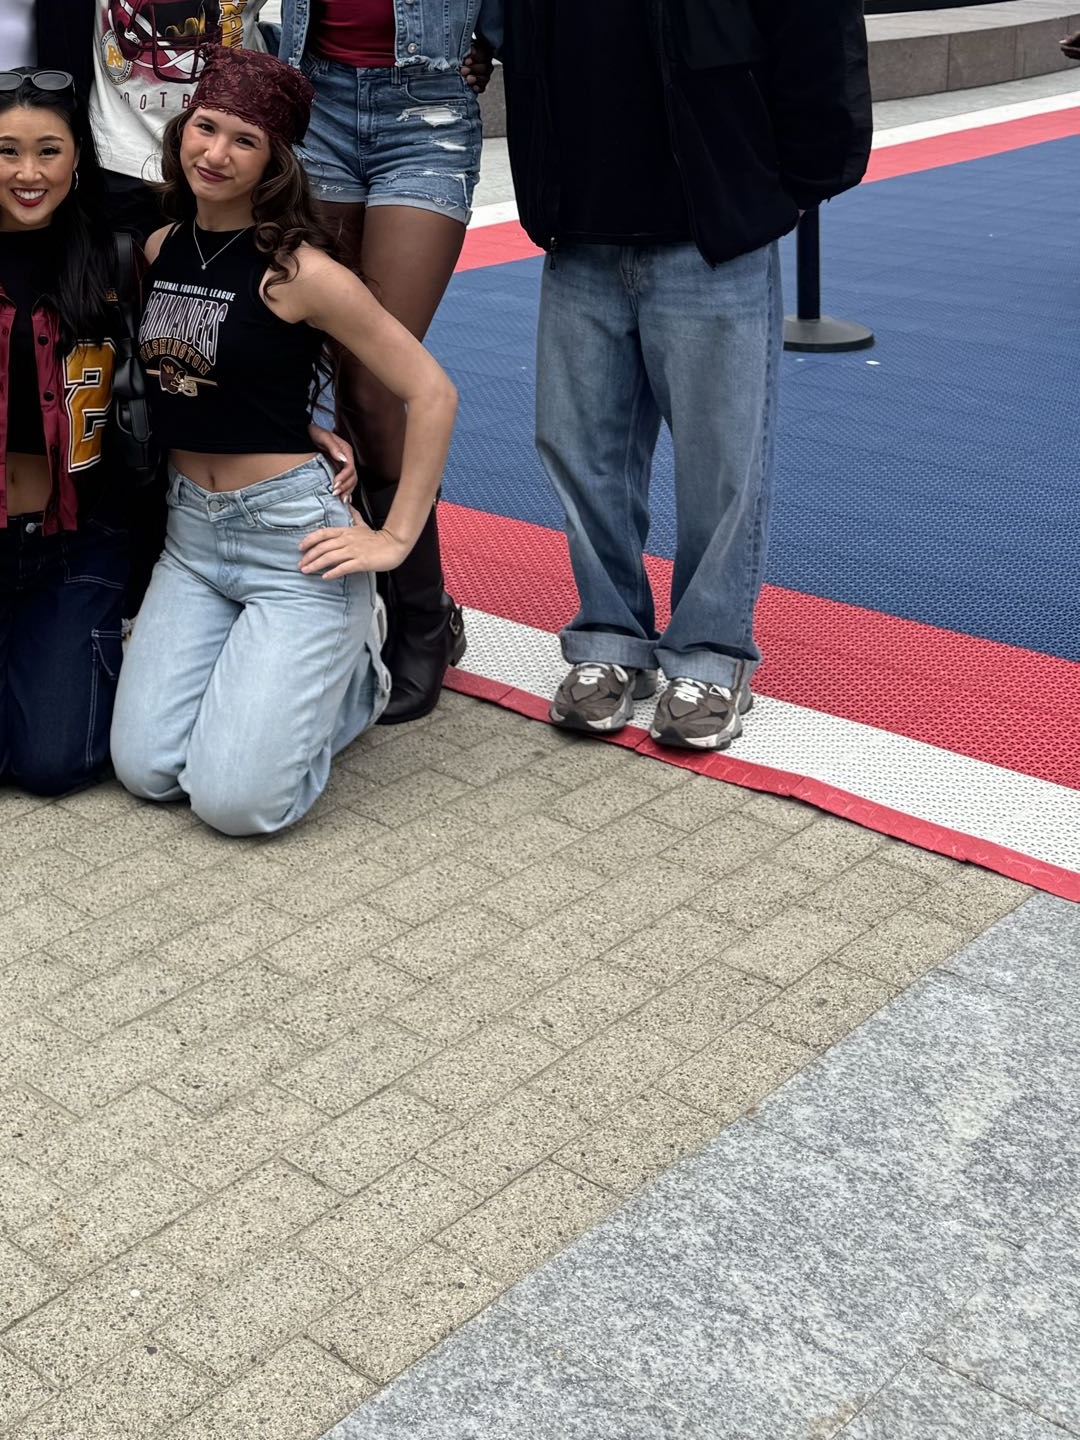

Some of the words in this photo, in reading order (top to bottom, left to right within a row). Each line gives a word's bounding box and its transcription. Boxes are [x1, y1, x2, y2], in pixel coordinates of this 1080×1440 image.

[153, 280, 179, 292] NATIONAL
[180, 284, 208, 296] FOOTBALL
[209, 288, 236, 302] LEAGUE
